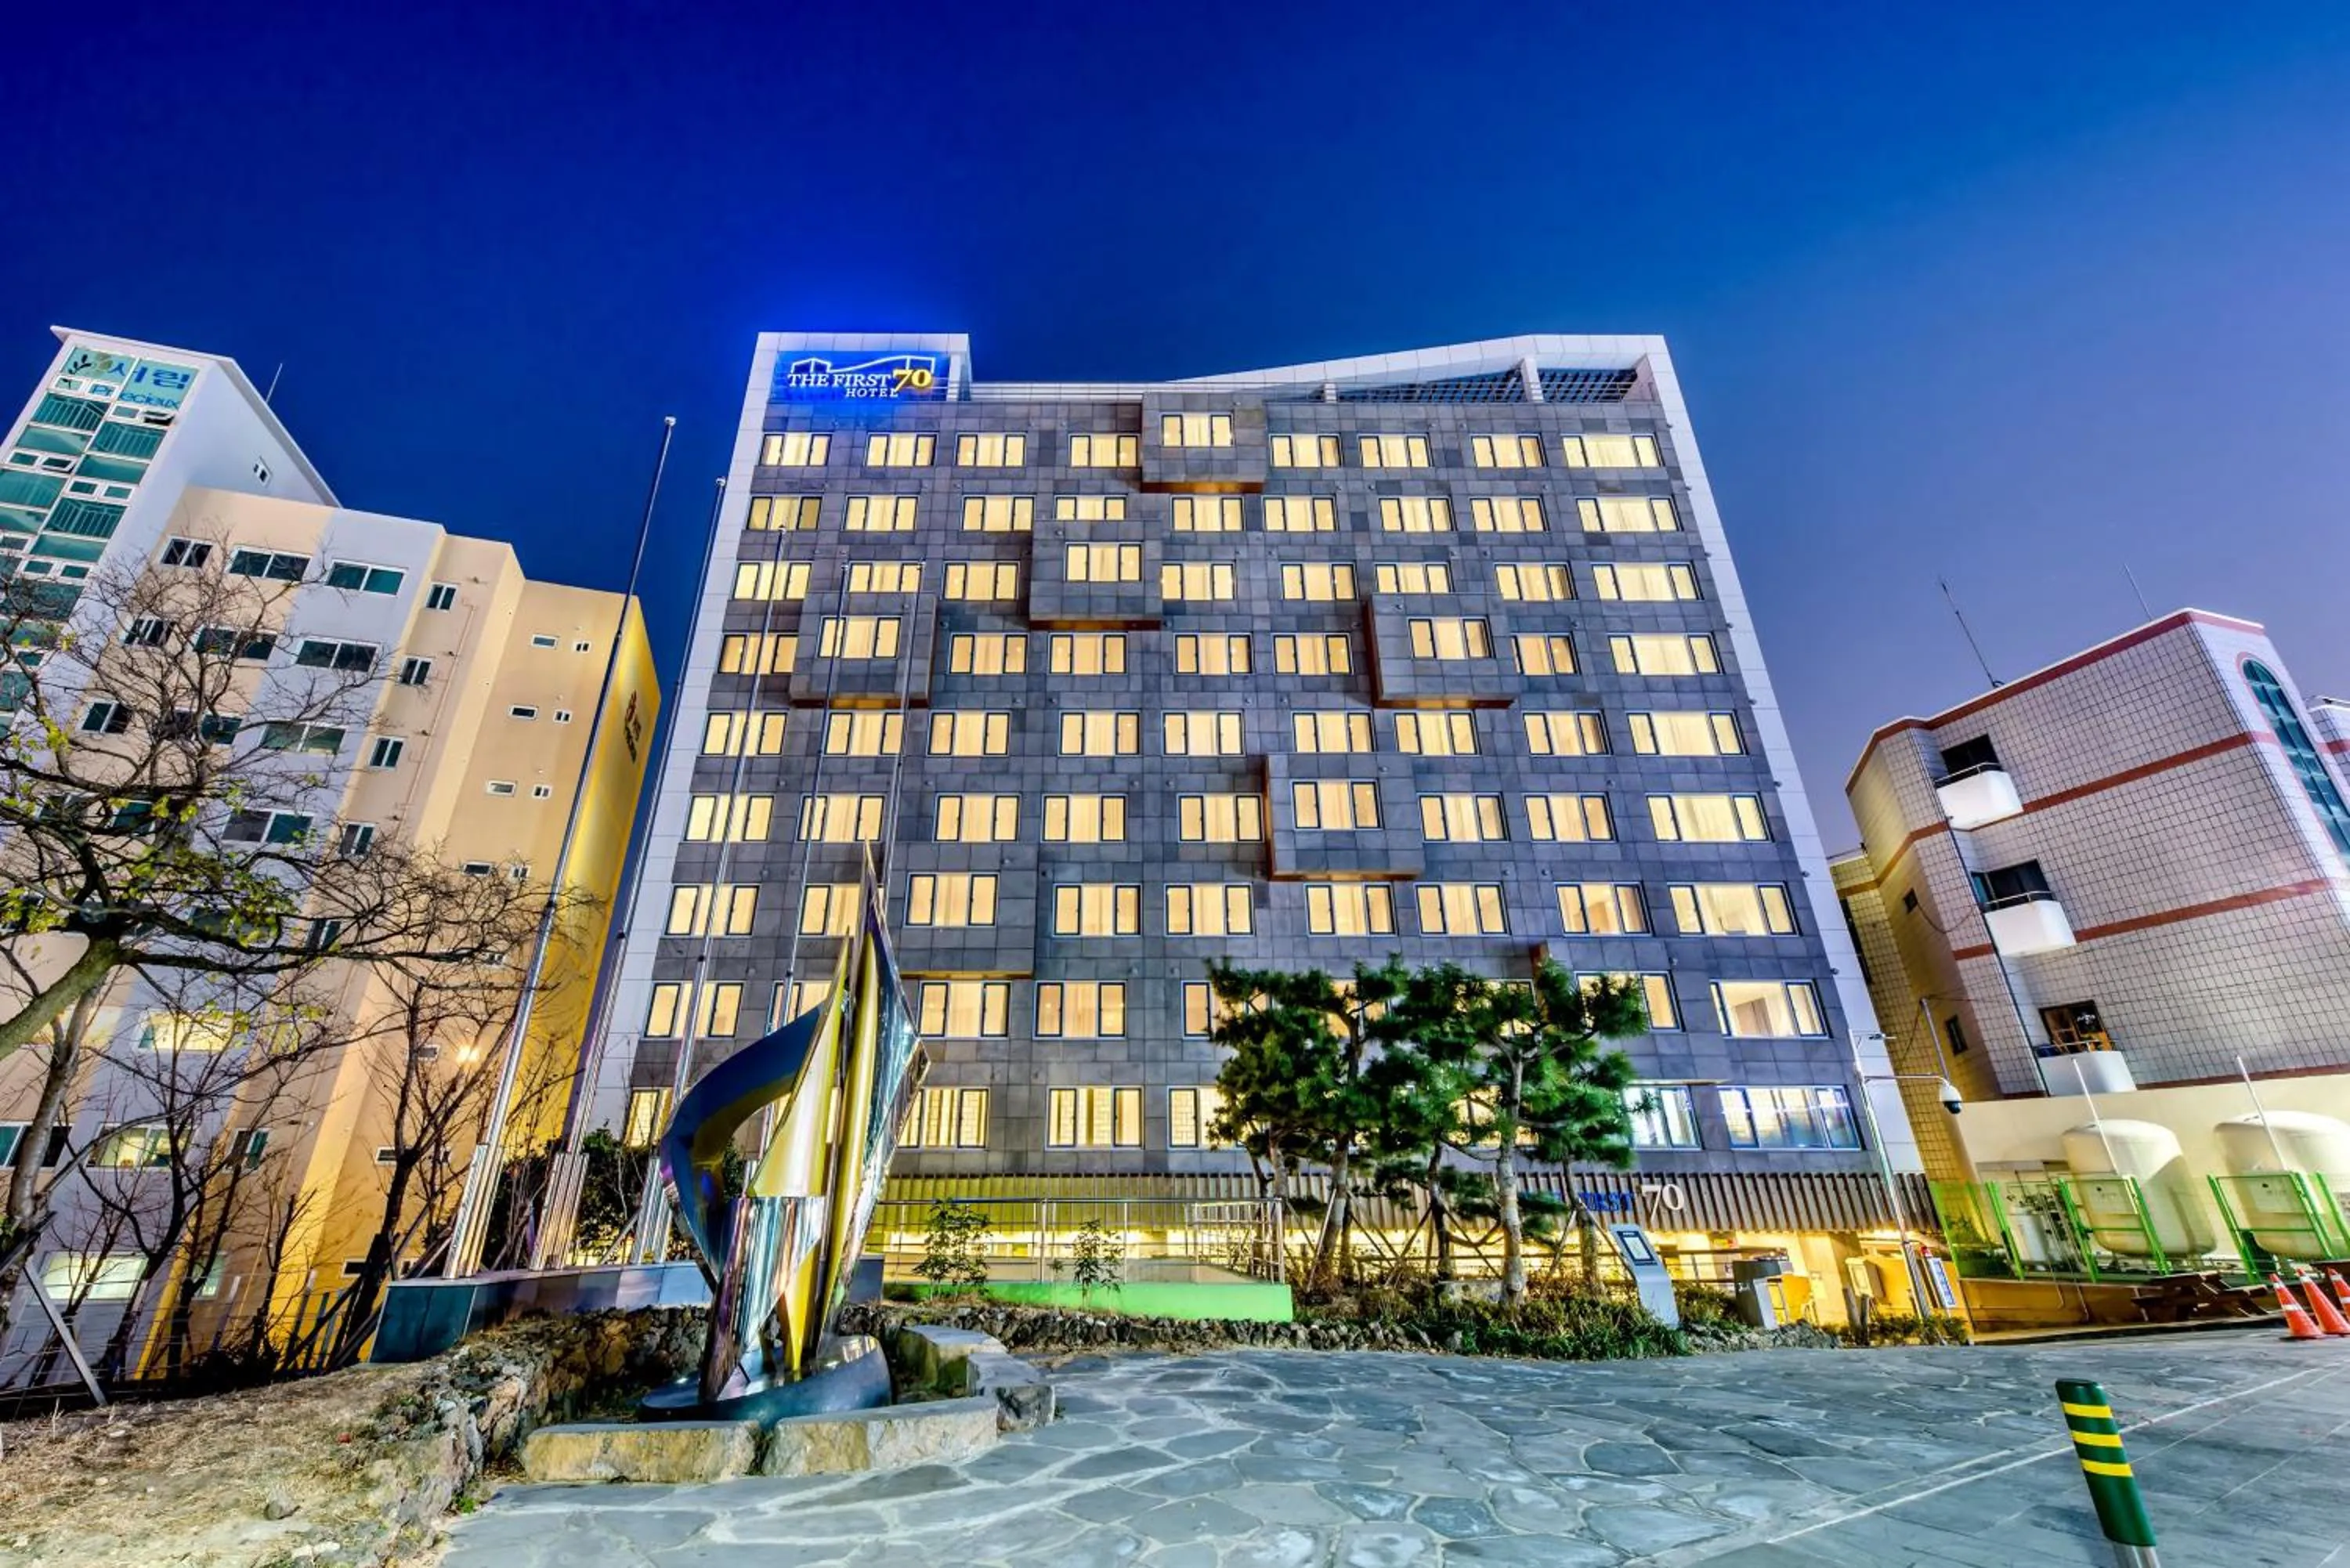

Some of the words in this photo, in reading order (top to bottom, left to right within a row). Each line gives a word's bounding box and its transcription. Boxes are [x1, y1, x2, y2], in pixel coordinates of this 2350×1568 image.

[787, 374, 829, 387] THE
[833, 374, 891, 387] FIRST
[892, 369, 932, 392] 70
[846, 388, 898, 398] HOTEL
[1640, 1183, 1685, 1222] 70
